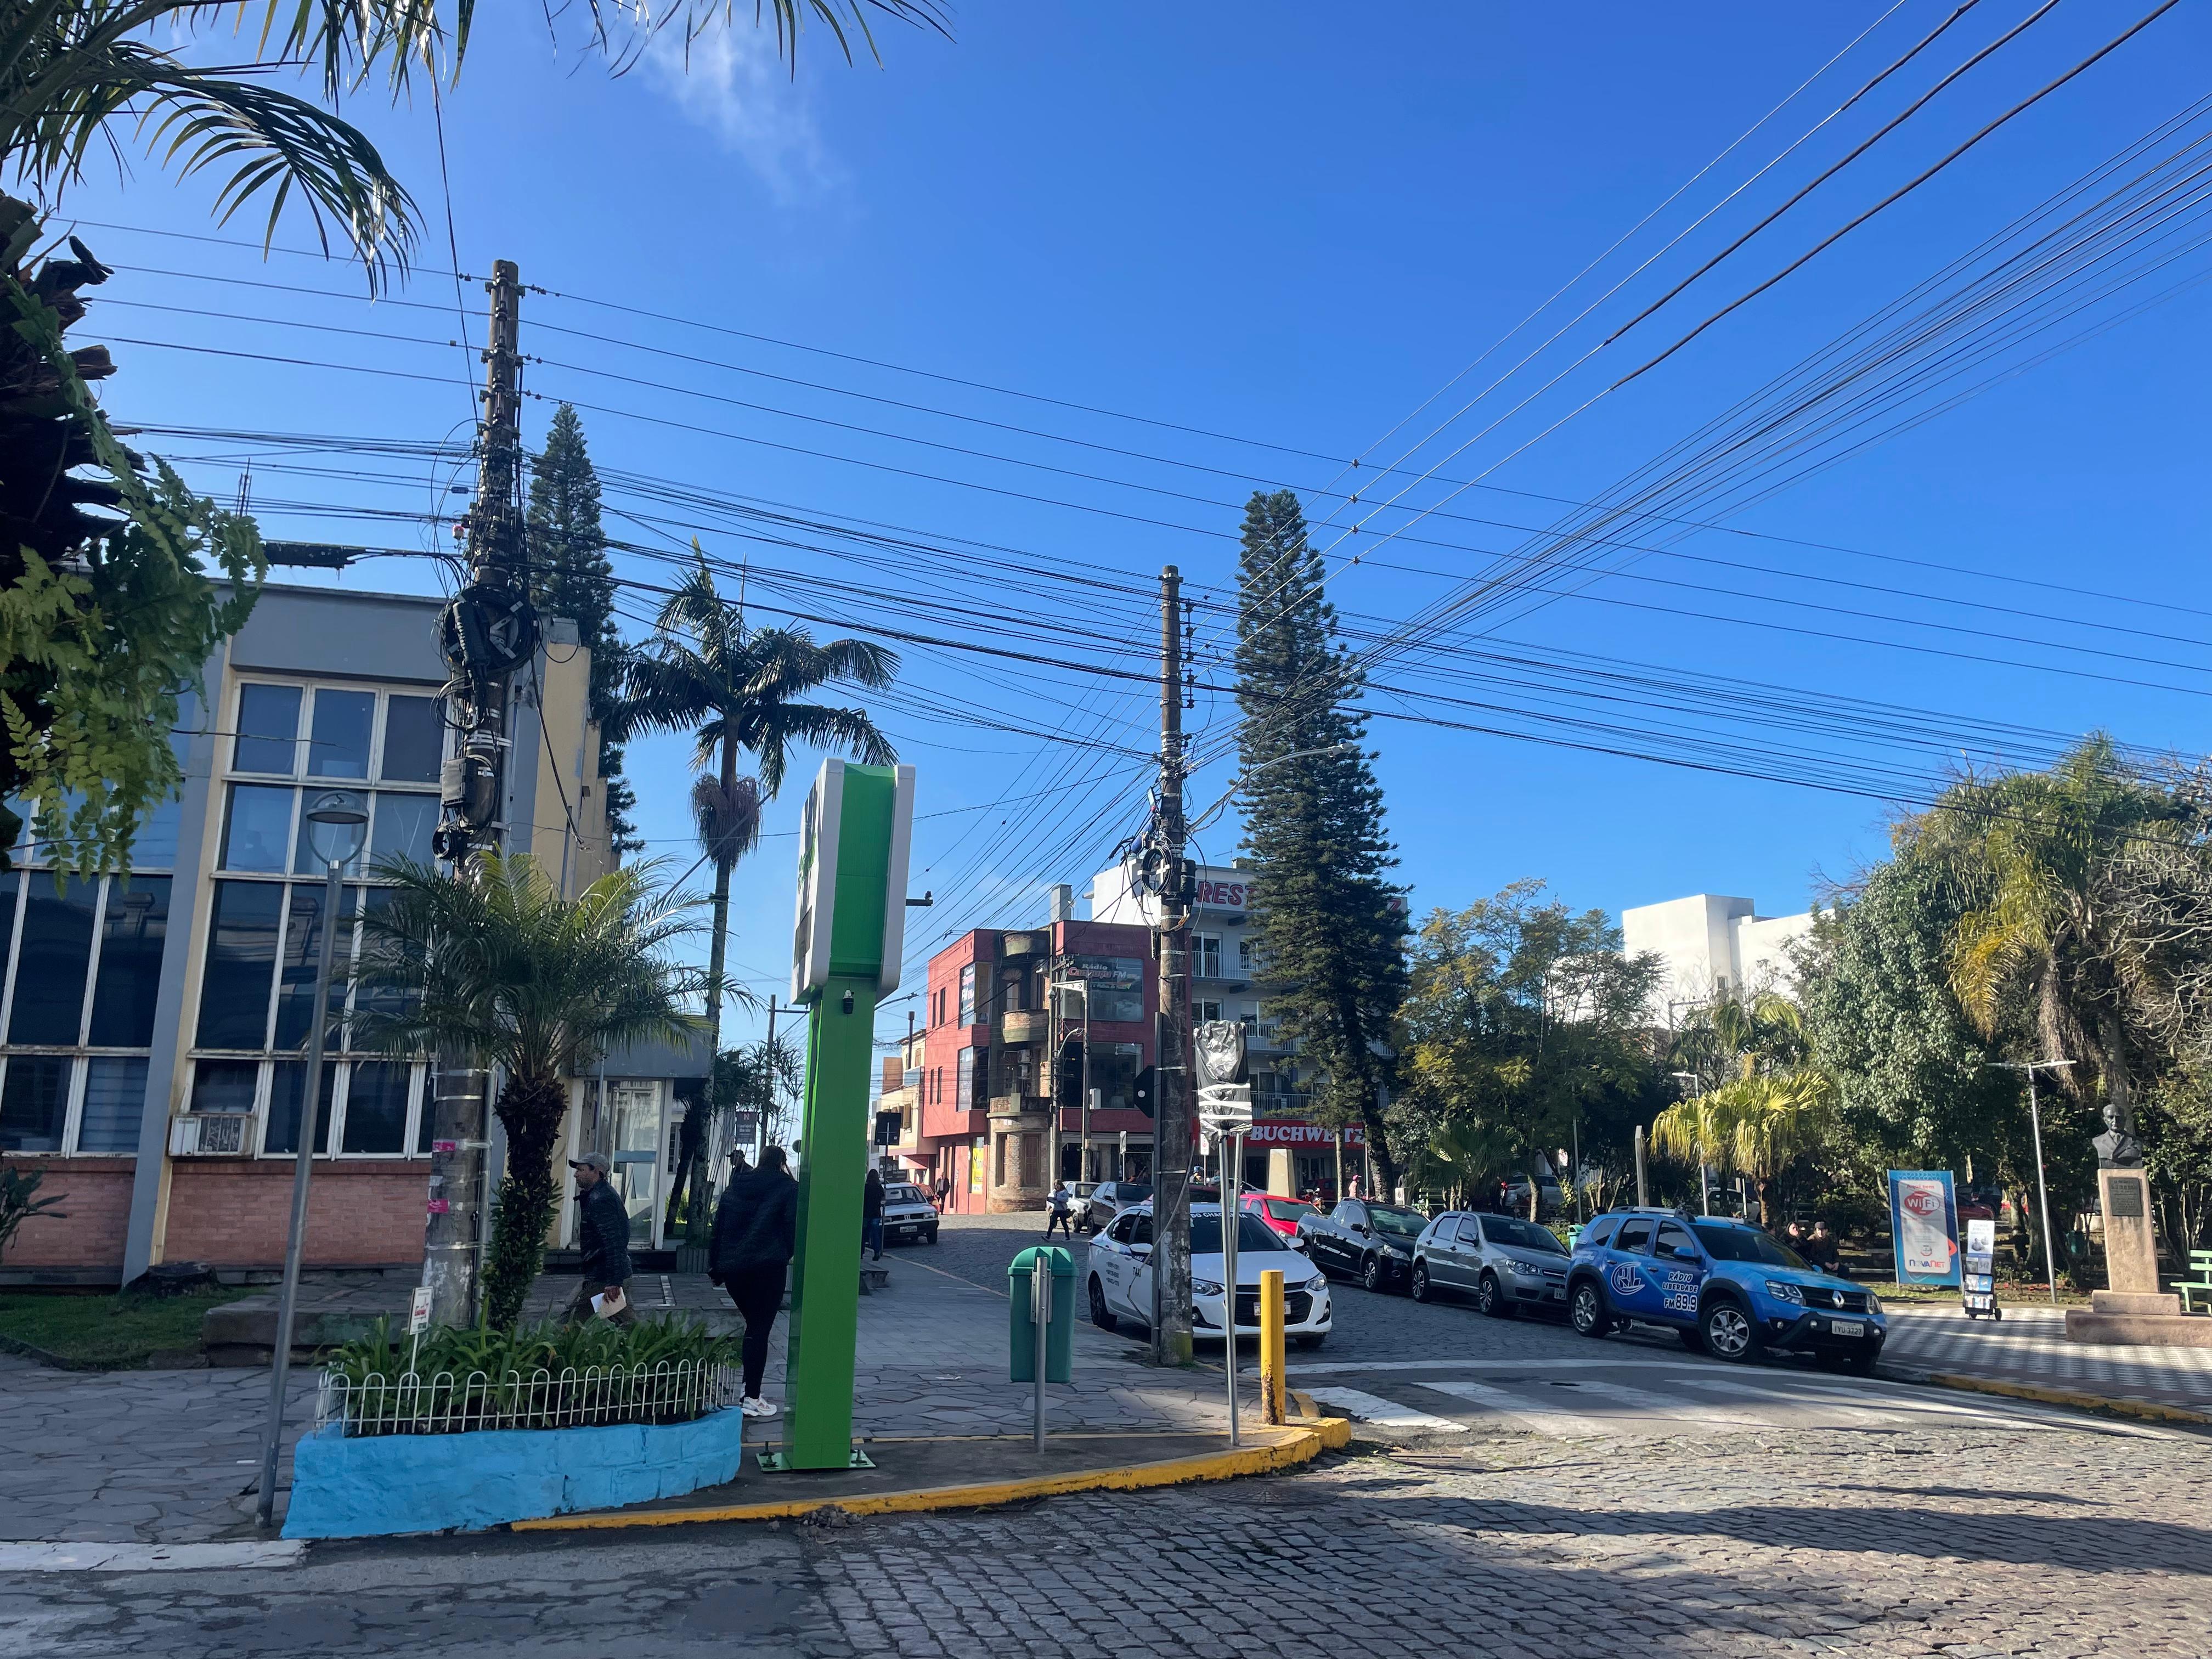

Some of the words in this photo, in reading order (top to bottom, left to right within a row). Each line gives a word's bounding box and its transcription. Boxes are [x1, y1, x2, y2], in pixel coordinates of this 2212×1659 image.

[1250, 1125, 1365, 1144] BUCHWETZ
[1668, 1271, 1694, 1283] RÁDIO
[1662, 1282, 1699, 1293] LIBERDADE
[1663, 1298, 1674, 1309] FM
[1675, 1293, 1697, 1312] 89.9
